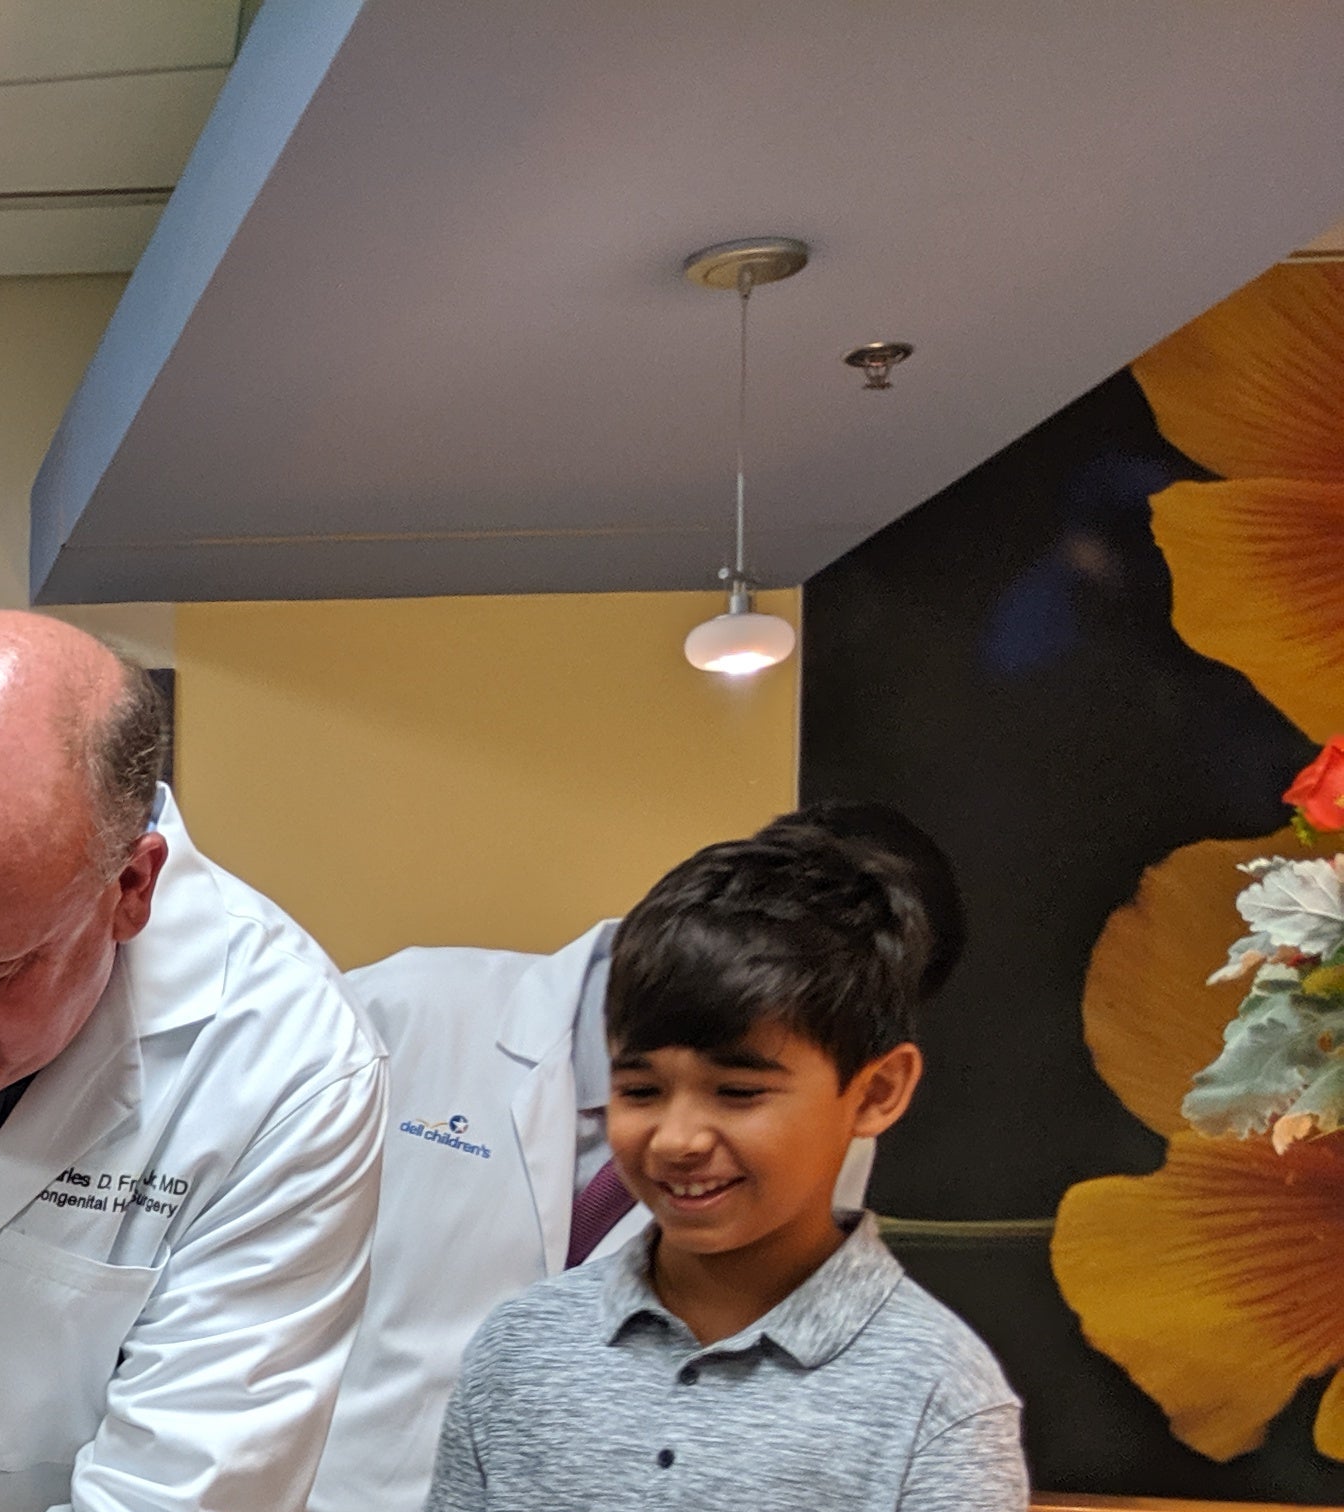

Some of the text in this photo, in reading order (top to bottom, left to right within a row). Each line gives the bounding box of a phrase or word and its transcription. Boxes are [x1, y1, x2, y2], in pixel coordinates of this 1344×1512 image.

[400, 1121, 491, 1159] dell children's
[159, 1176, 189, 1196] MD
[38, 1189, 109, 1212] ongenital
